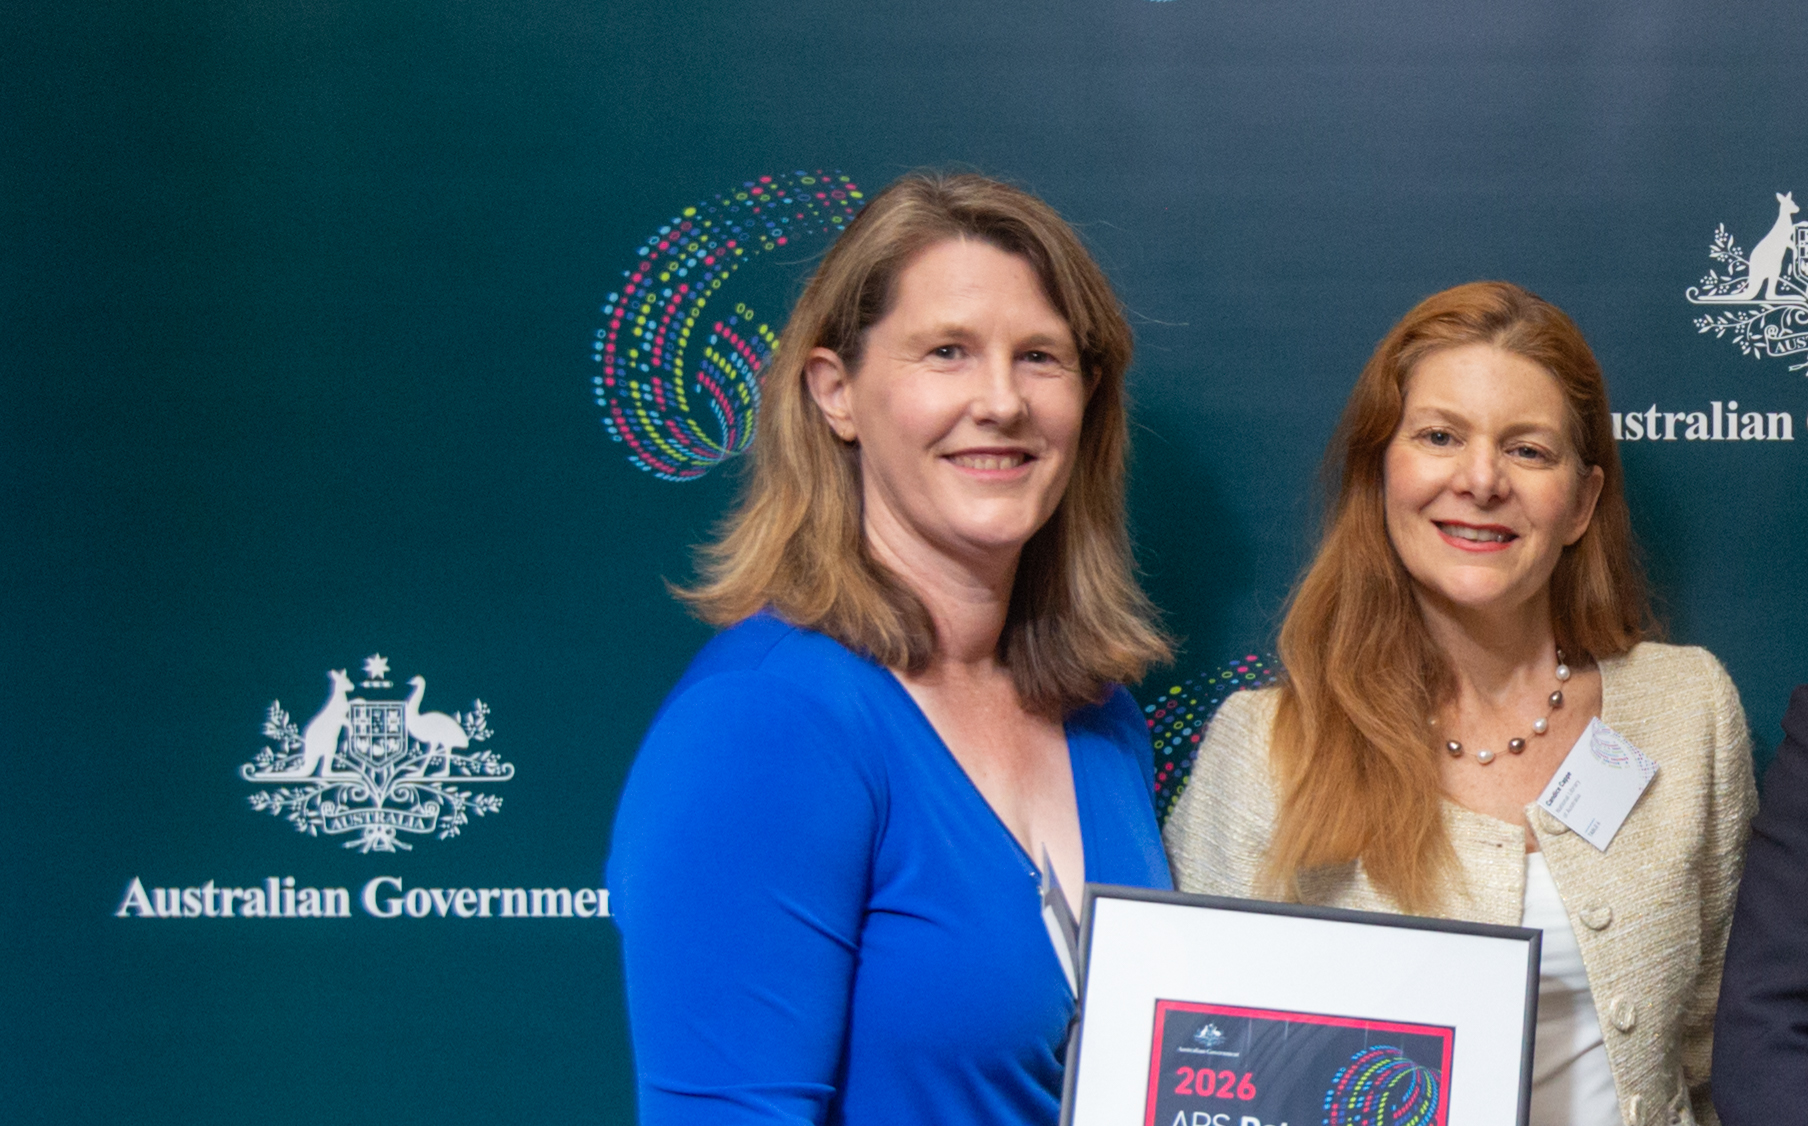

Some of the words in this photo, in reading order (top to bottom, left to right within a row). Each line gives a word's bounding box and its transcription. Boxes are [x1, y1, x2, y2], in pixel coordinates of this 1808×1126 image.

[1611, 400, 1795, 441] stralian
[331, 811, 425, 830] AUSTRALIA
[115, 876, 351, 918] Australian
[363, 876, 610, 918] Governme
[1174, 1065, 1257, 1101] 2026
